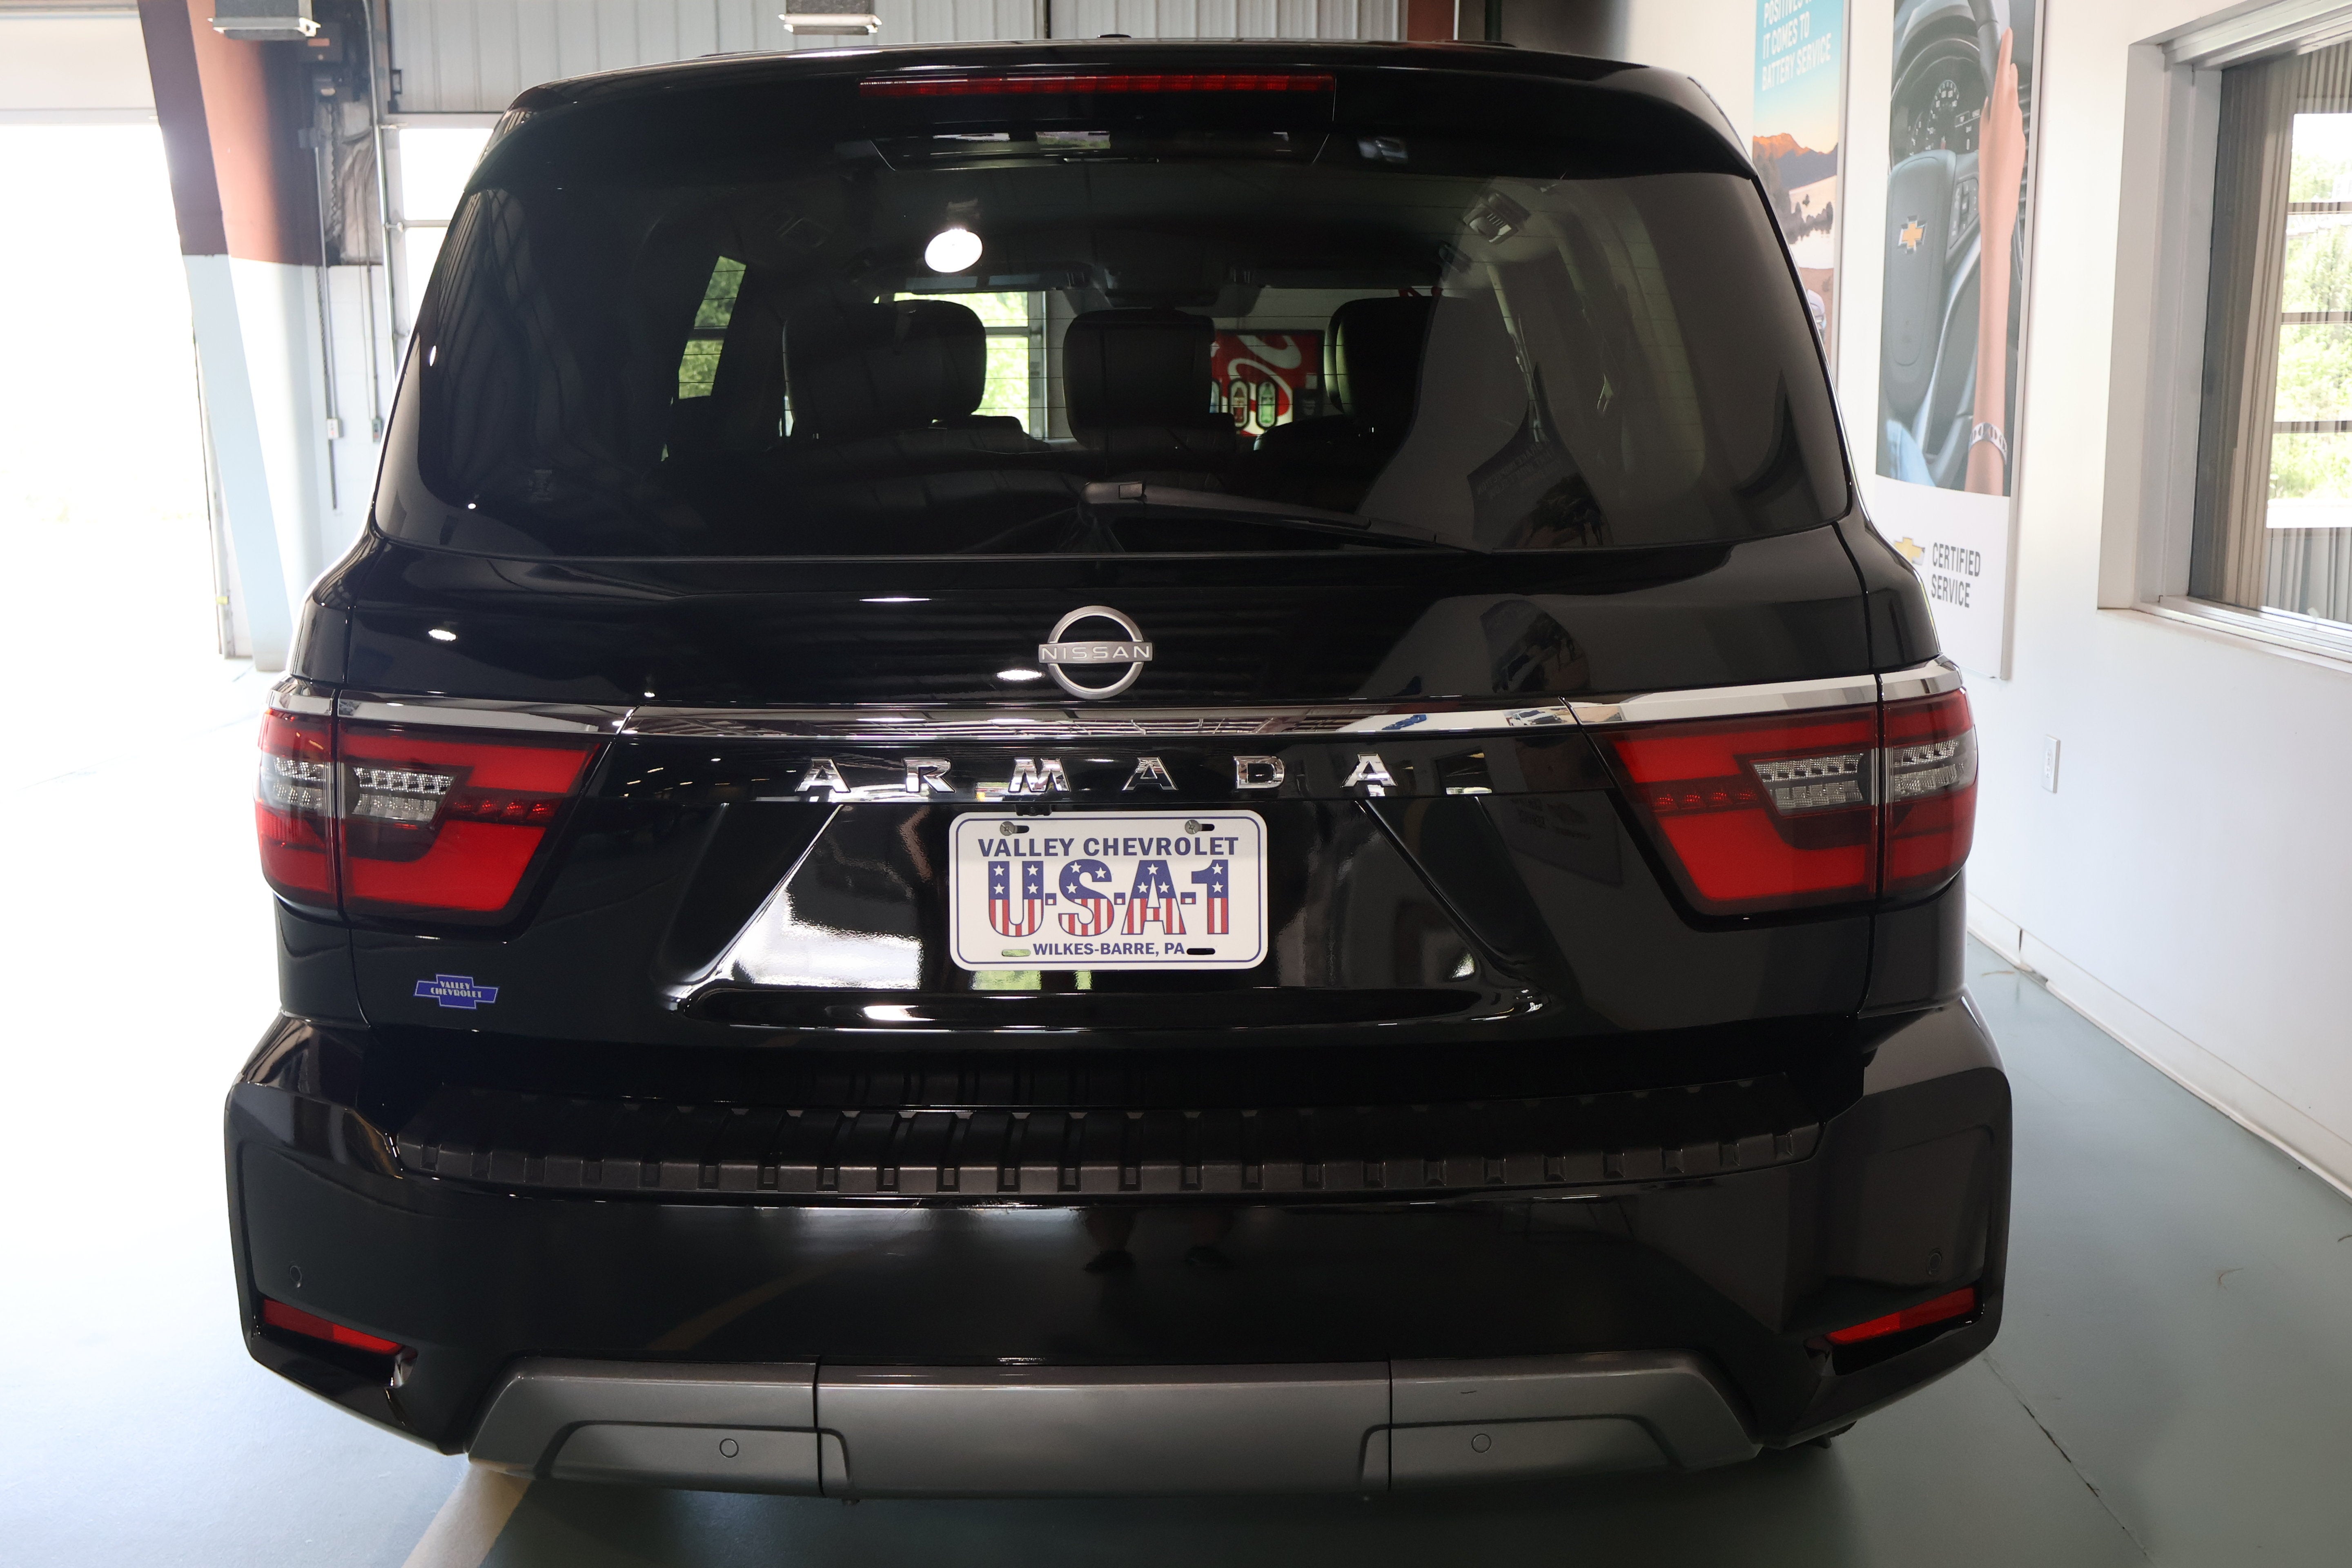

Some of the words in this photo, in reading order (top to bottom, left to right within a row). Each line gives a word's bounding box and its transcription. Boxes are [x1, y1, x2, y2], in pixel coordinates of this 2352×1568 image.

[1762, 33, 1771, 60] IT
[1771, 18, 1798, 55] COMES
[1800, 11, 1810, 40] TO
[1762, 51, 1796, 91] BATTERY
[1797, 33, 1832, 76] SERVICE
[1932, 542, 1980, 577] CERTIFIED
[1931, 574, 1971, 608] SERVICE
[1042, 646, 1149, 660] NISSAN
[795, 752, 1397, 793] ARMADA
[978, 838, 1075, 857] VALLEY
[1083, 837, 1238, 856] CHEVROLET
[1033, 943, 1159, 957] WILKES-BARRE,
[1165, 943, 1185, 955] PA
[430, 987, 482, 998] CHEVROLET
[440, 981, 470, 990] VALLEY
